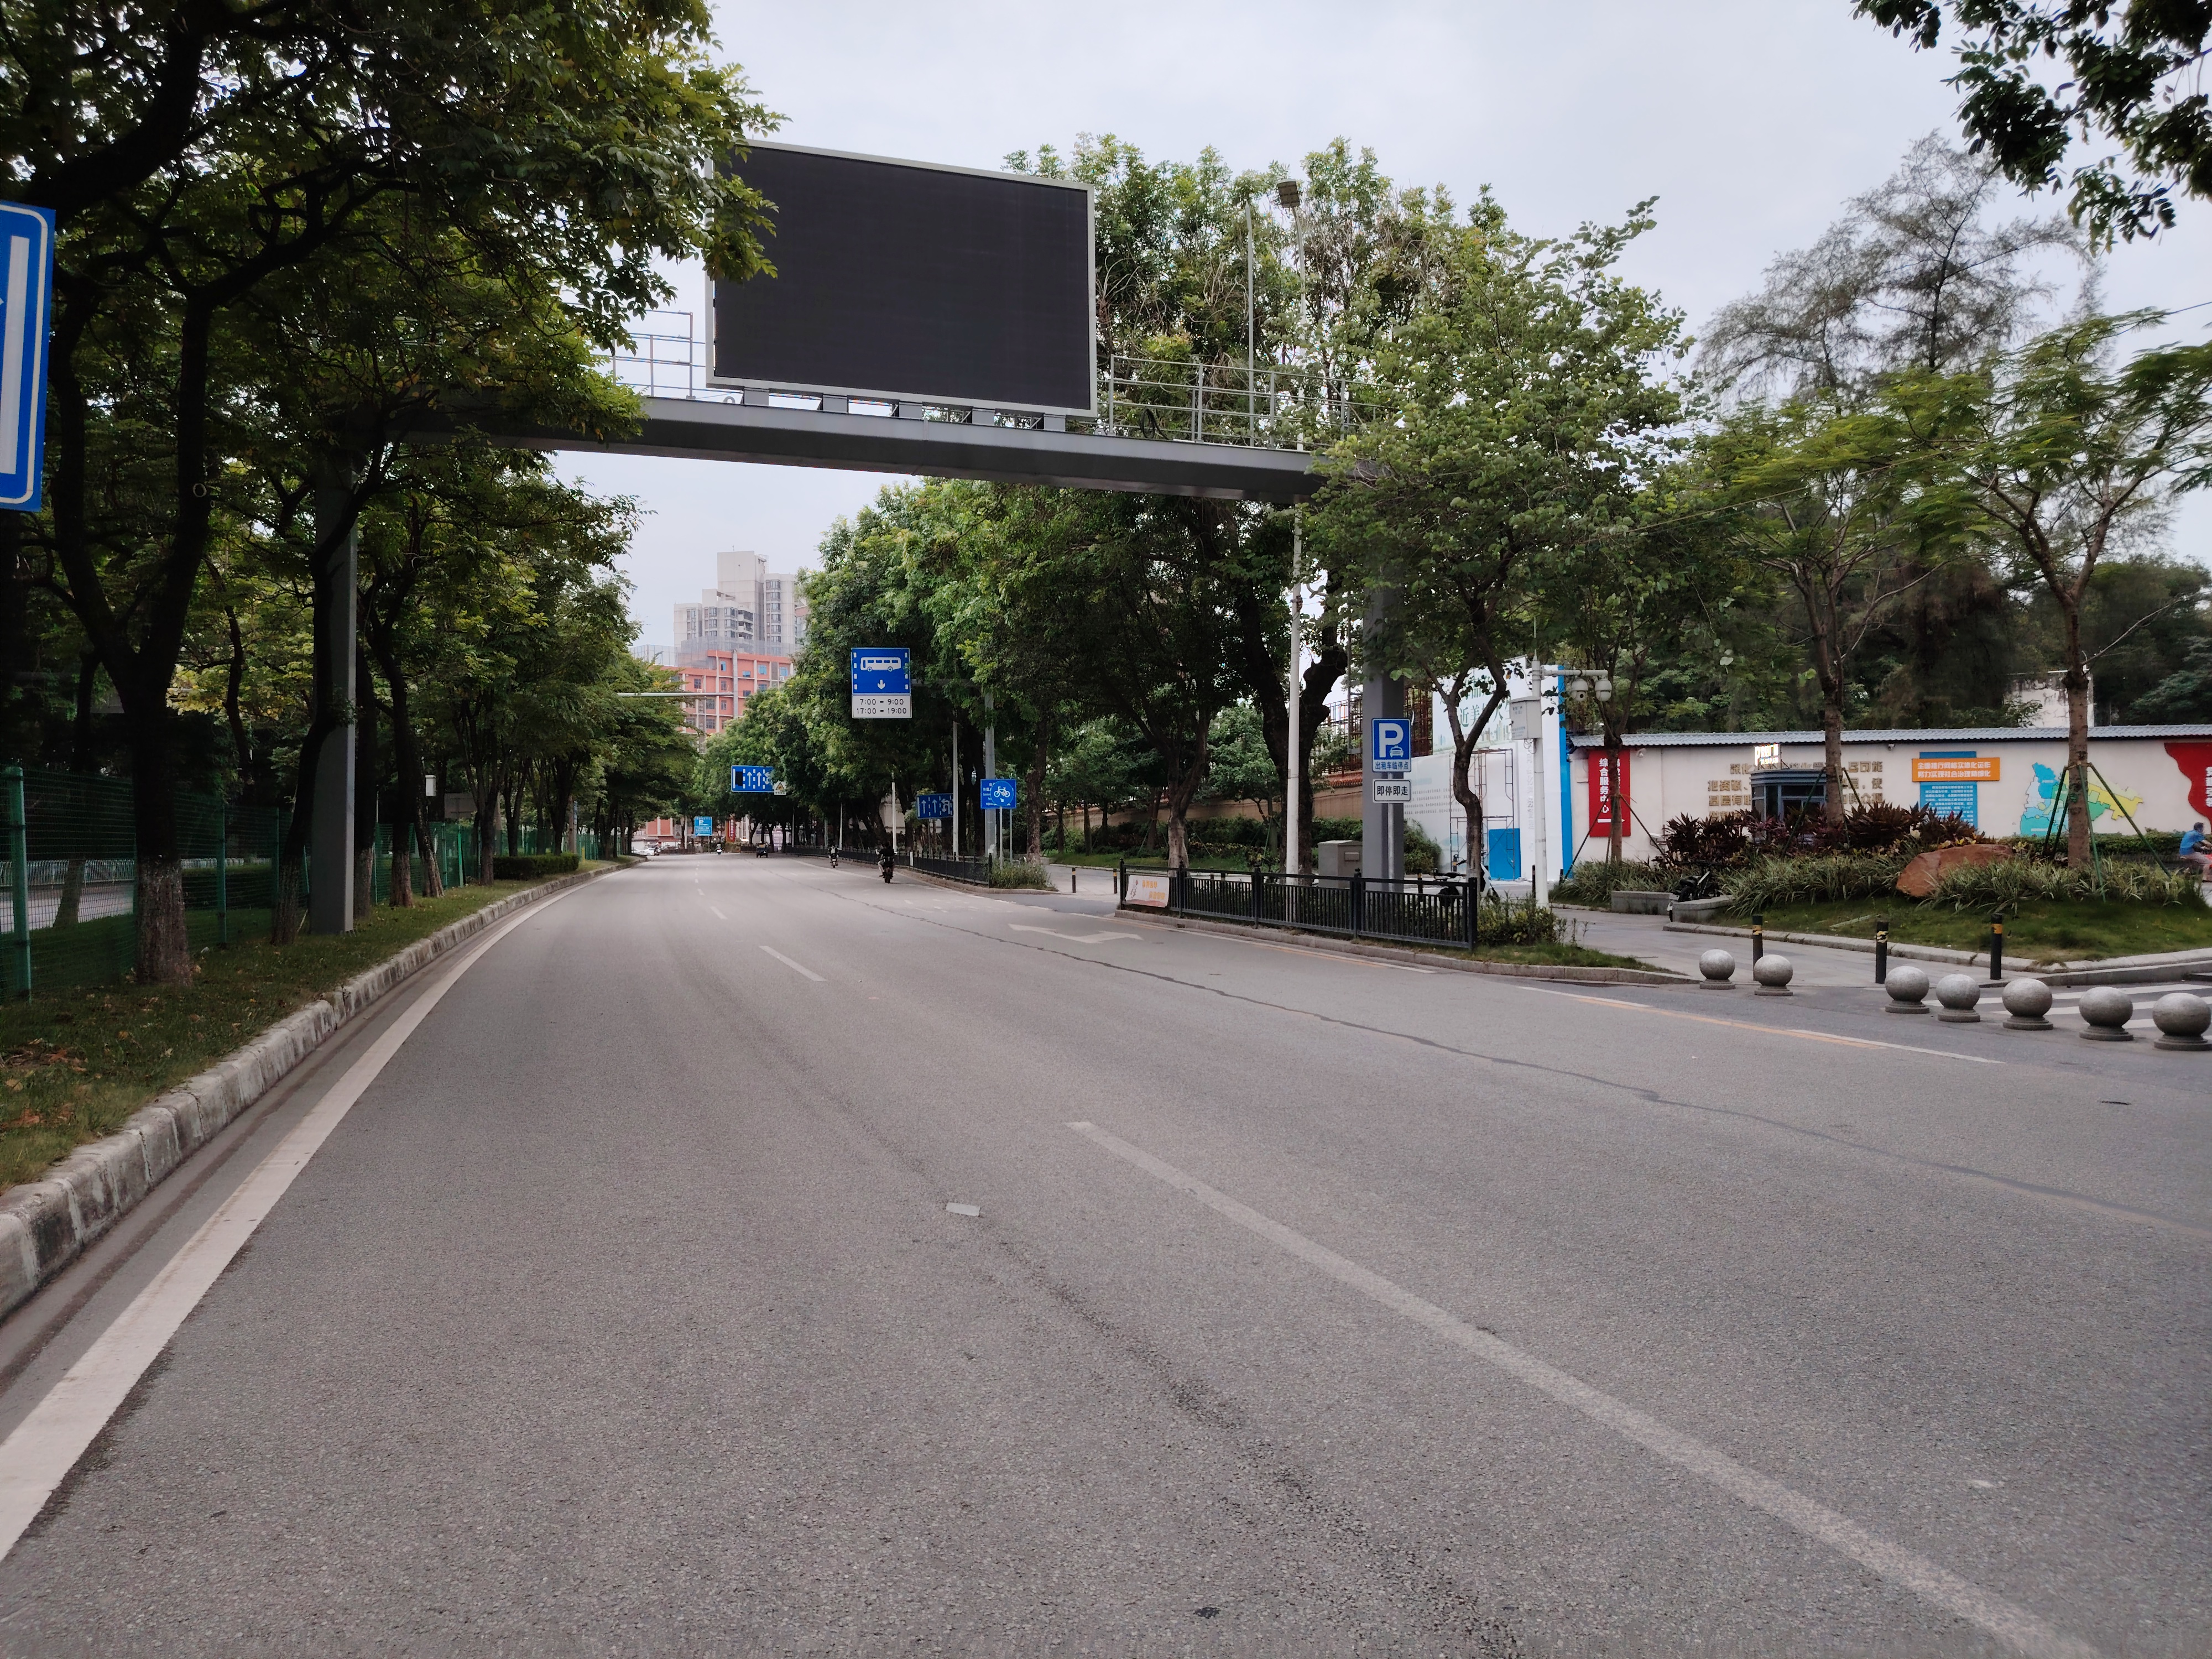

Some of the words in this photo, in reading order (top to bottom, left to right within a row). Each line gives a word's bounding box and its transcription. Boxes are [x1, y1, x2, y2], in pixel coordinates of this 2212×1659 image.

[1379, 723, 1404, 758] P
[1375, 761, 1408, 770] 出租车临停点
[1377, 785, 1408, 796] 即停即走
[1599, 758, 1609, 813] 综合服务中心
